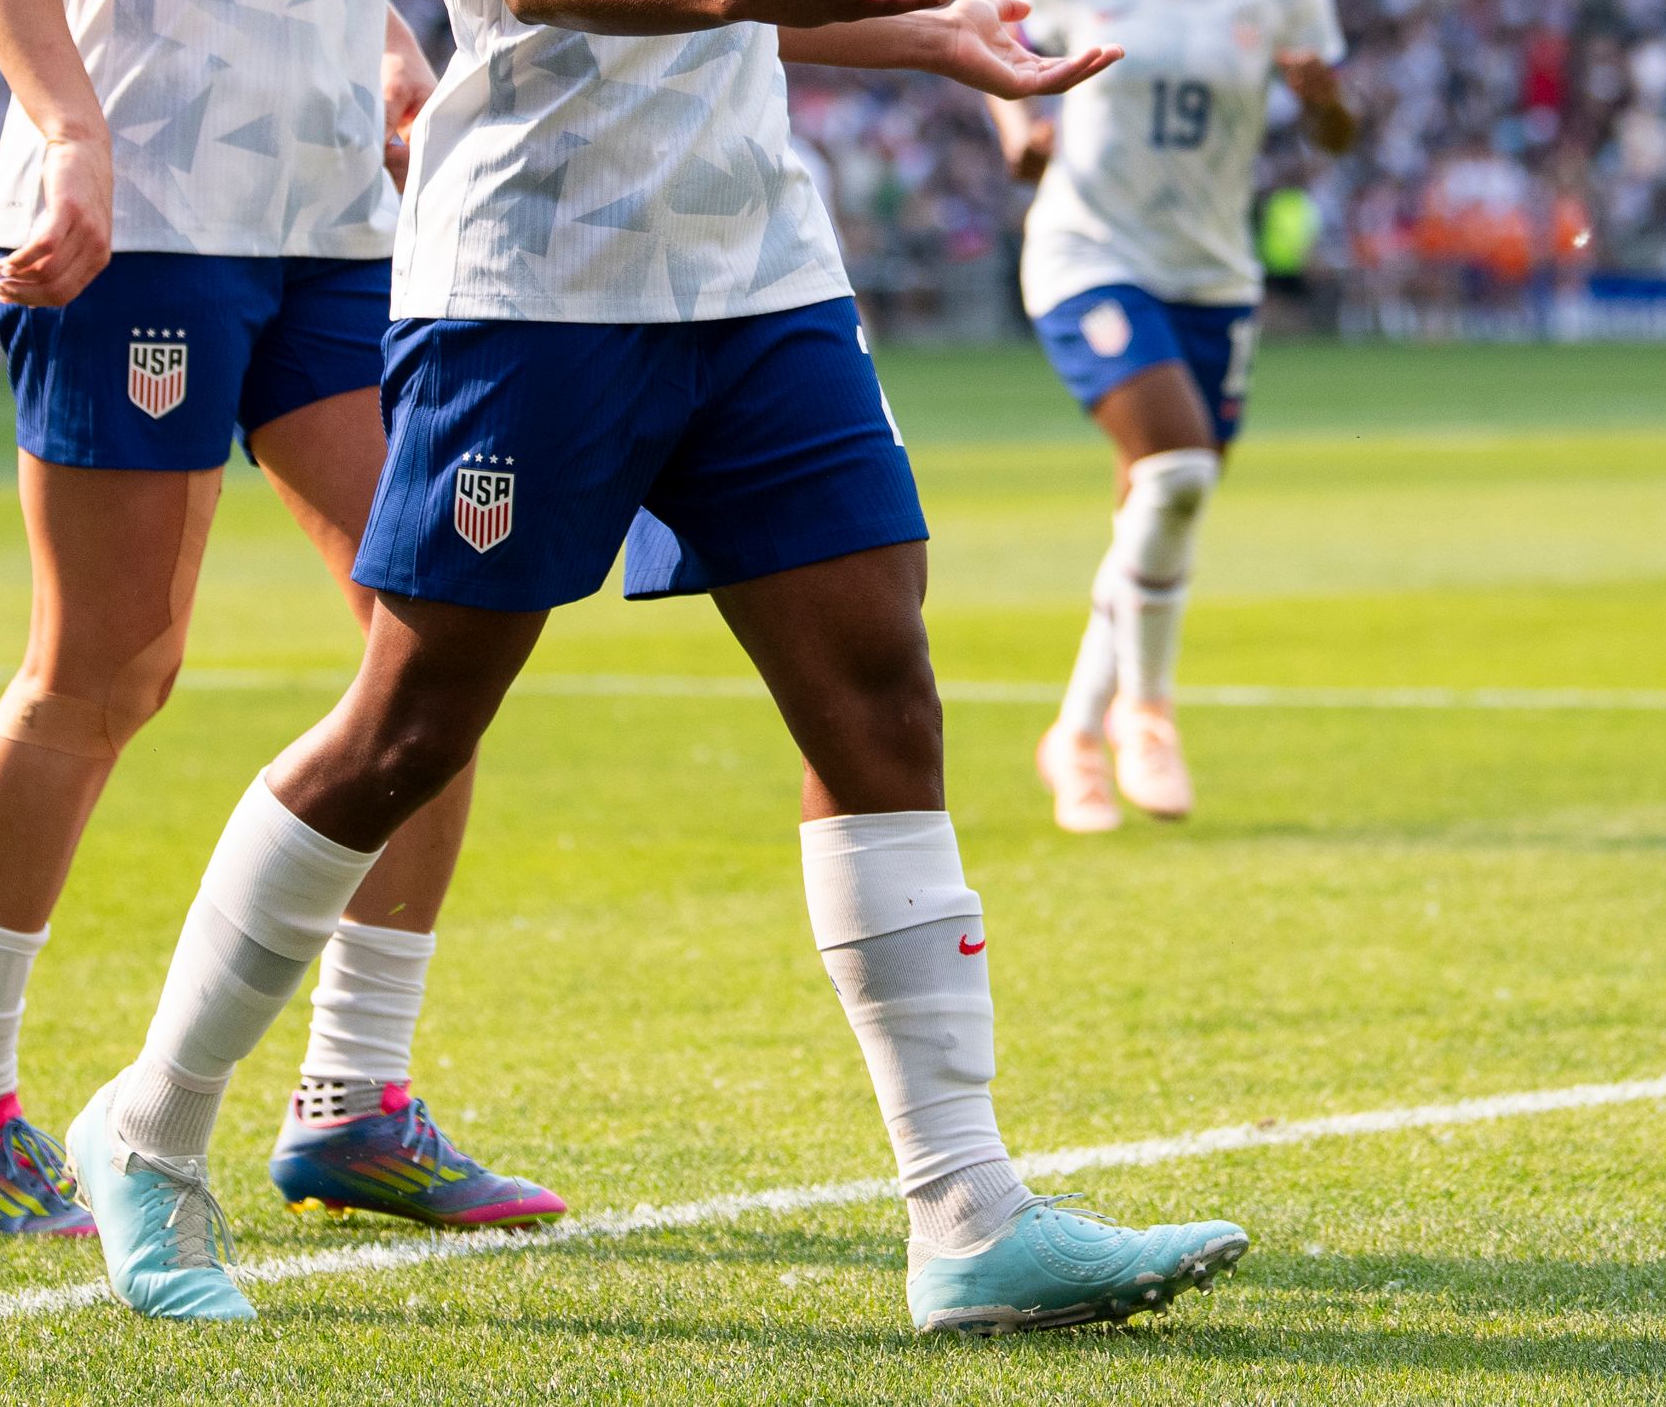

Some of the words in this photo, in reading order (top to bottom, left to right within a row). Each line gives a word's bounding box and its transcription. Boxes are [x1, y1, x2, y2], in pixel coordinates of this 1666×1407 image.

[1151, 79, 1211, 148] 19
[134, 347, 183, 376] USA
[460, 473, 511, 507] USA
